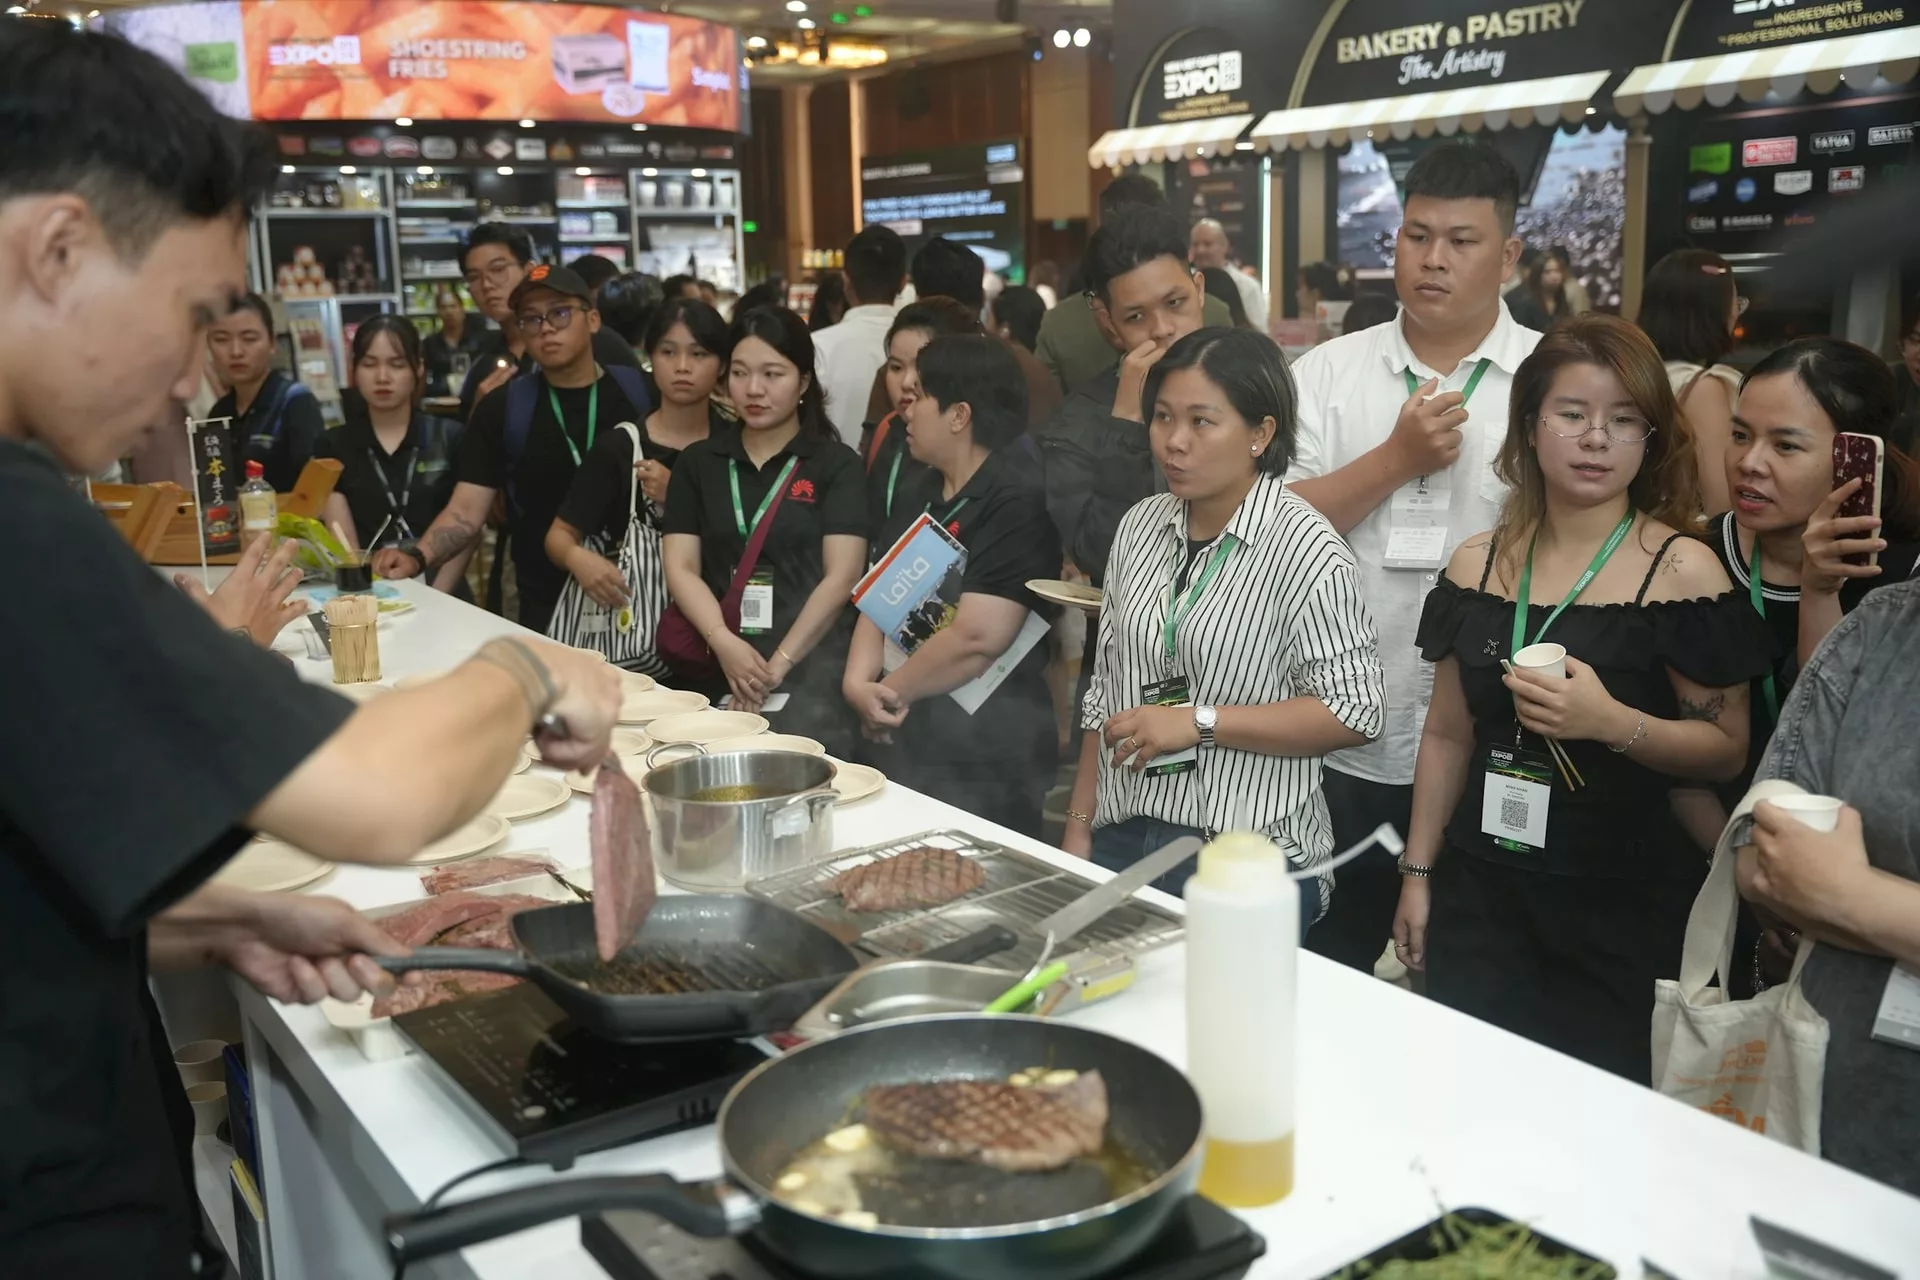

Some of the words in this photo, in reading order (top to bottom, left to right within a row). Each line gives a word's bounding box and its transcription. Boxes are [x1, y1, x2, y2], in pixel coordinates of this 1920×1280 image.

[1774, 1, 1864, 25] INGREDIENTS
[1337, 21, 1444, 64] BAKERY
[1446, 26, 1463, 47] &
[1467, 0, 1584, 44] PASTRY
[1727, 22, 1825, 47] PROFESSIONAL
[1825, 8, 1905, 32] SOLUTIONS
[268, 45, 334, 66] EXPO
[389, 38, 526, 60] SHOESTRING
[388, 59, 448, 79] FRIES
[1398, 53, 1432, 85] The
[1431, 49, 1507, 79] Artistry
[1164, 67, 1219, 99] EXPO
